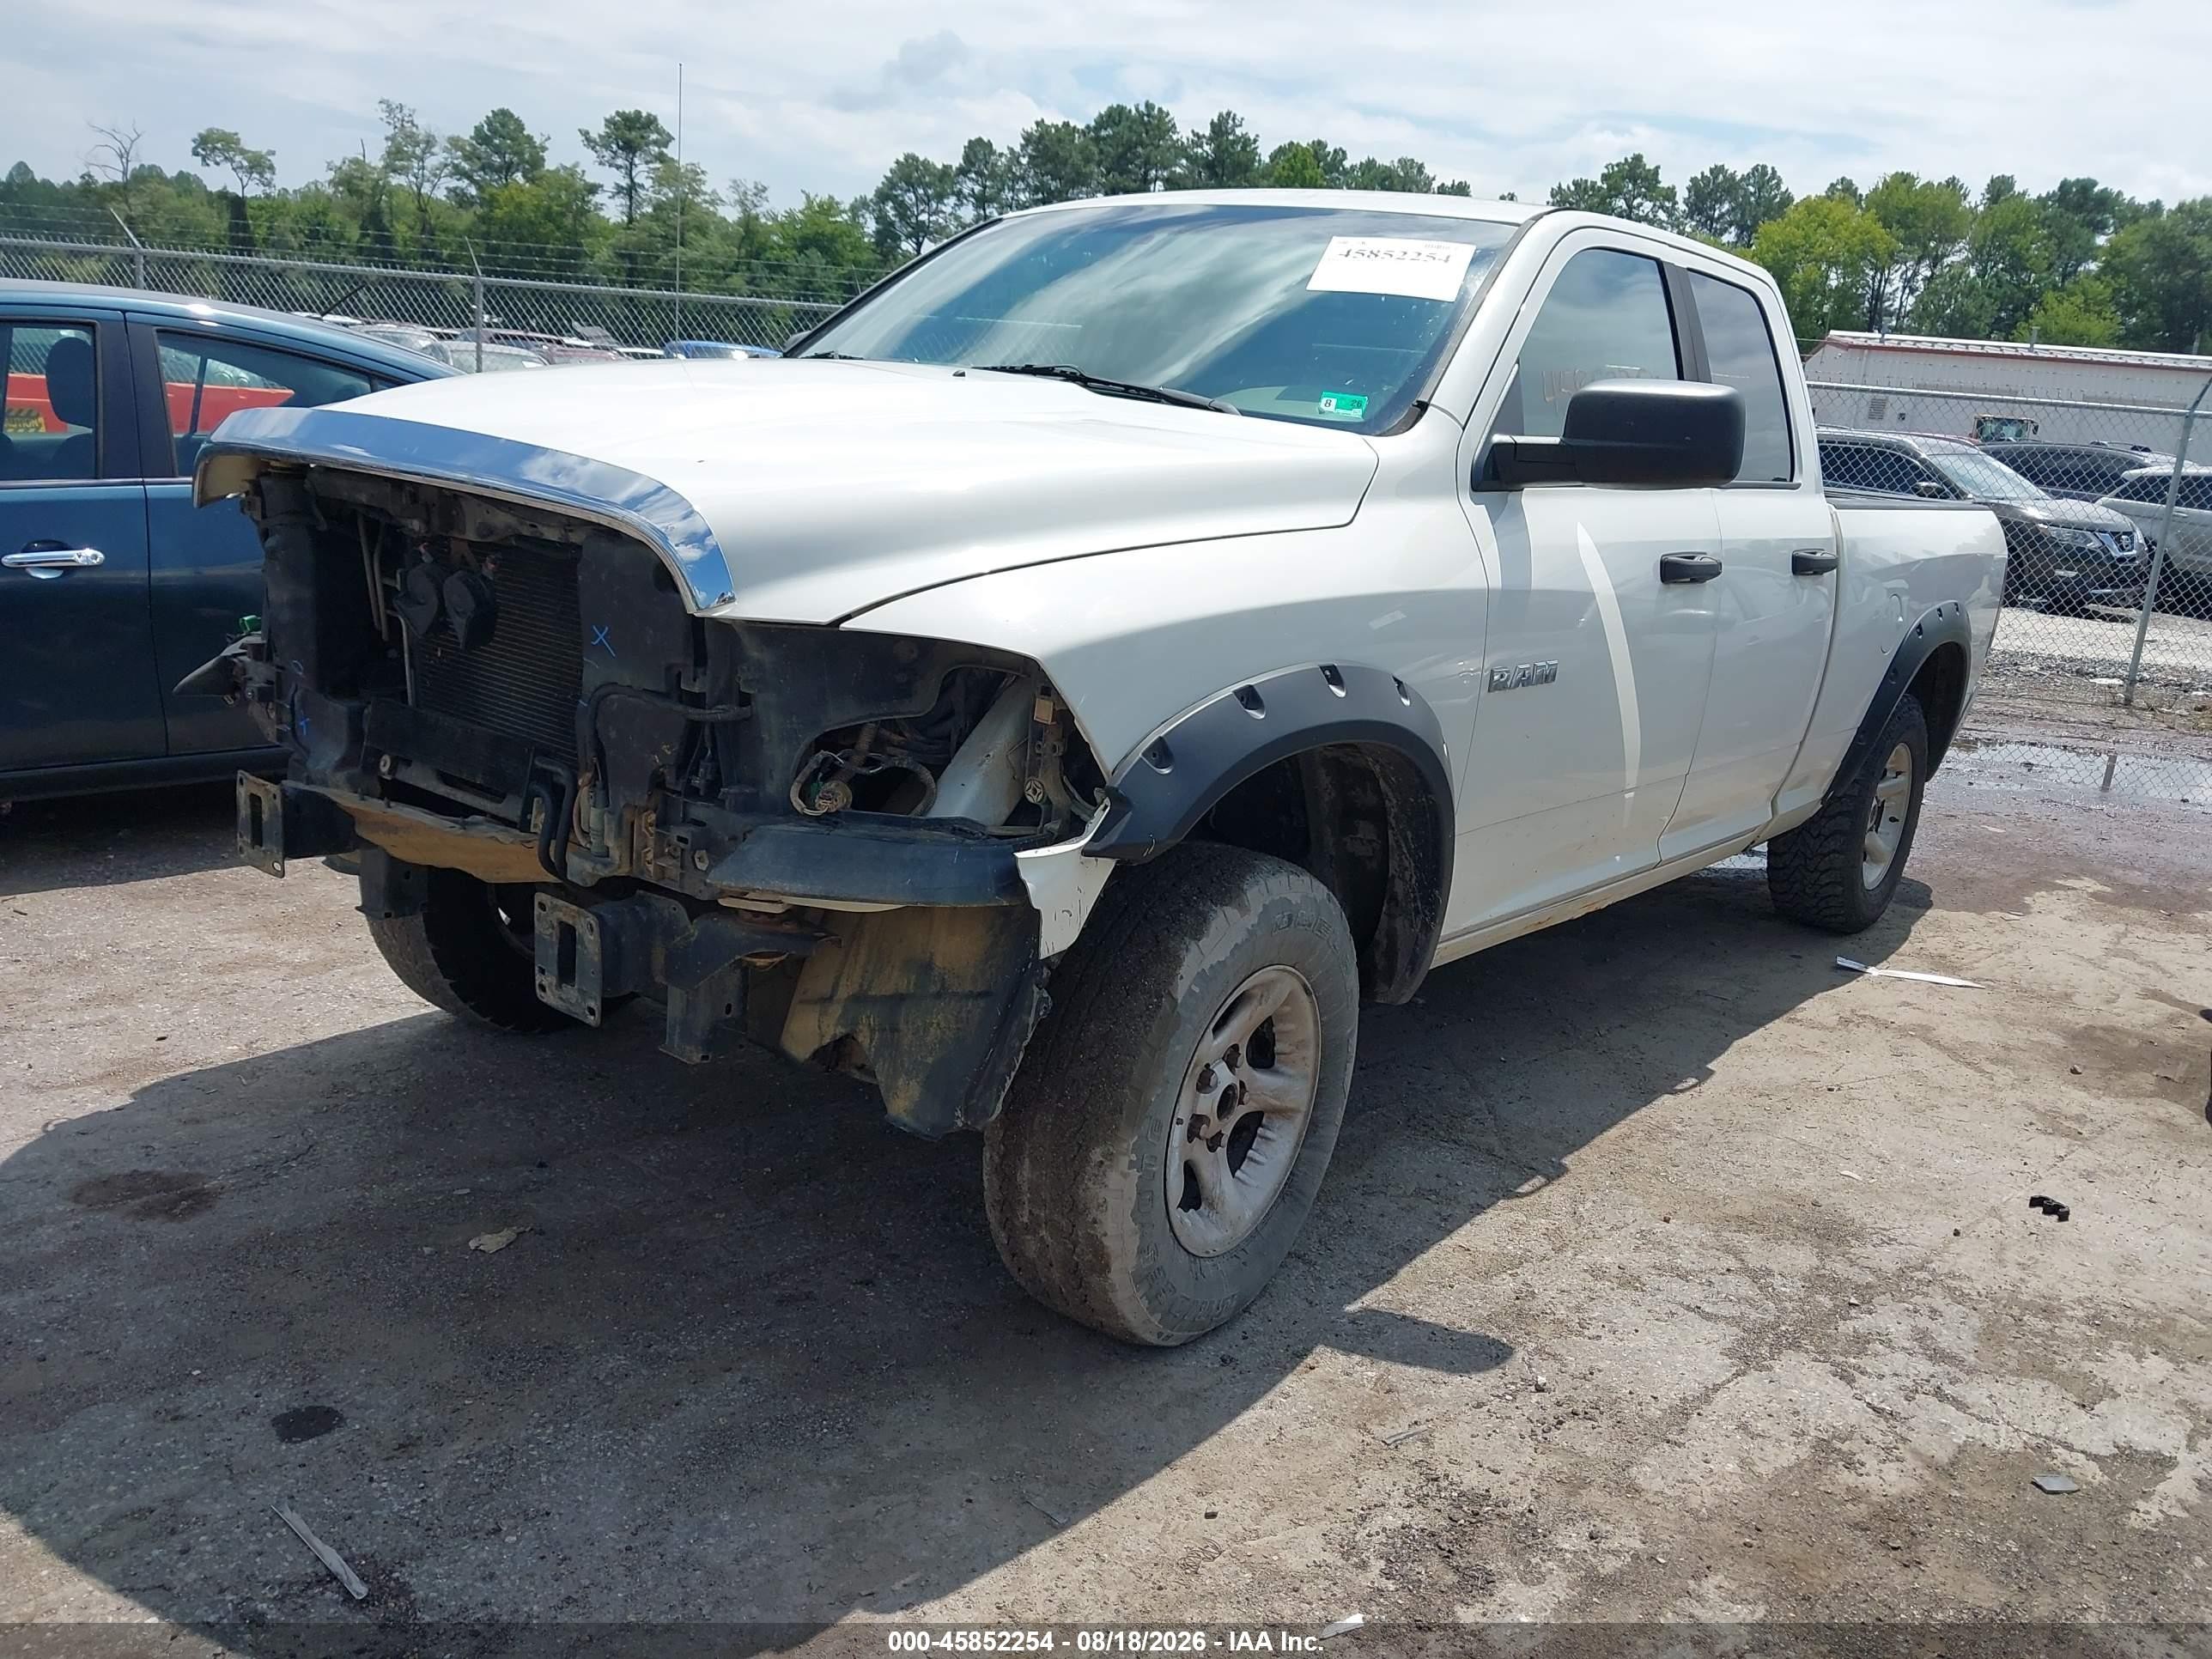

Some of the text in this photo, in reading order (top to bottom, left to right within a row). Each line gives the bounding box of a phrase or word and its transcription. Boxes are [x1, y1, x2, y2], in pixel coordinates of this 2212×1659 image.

[1338, 248, 1451, 264] 45852254
[1324, 398, 1333, 408] 8
[1350, 398, 1363, 409] 26
[1487, 659, 1559, 693] RAM
